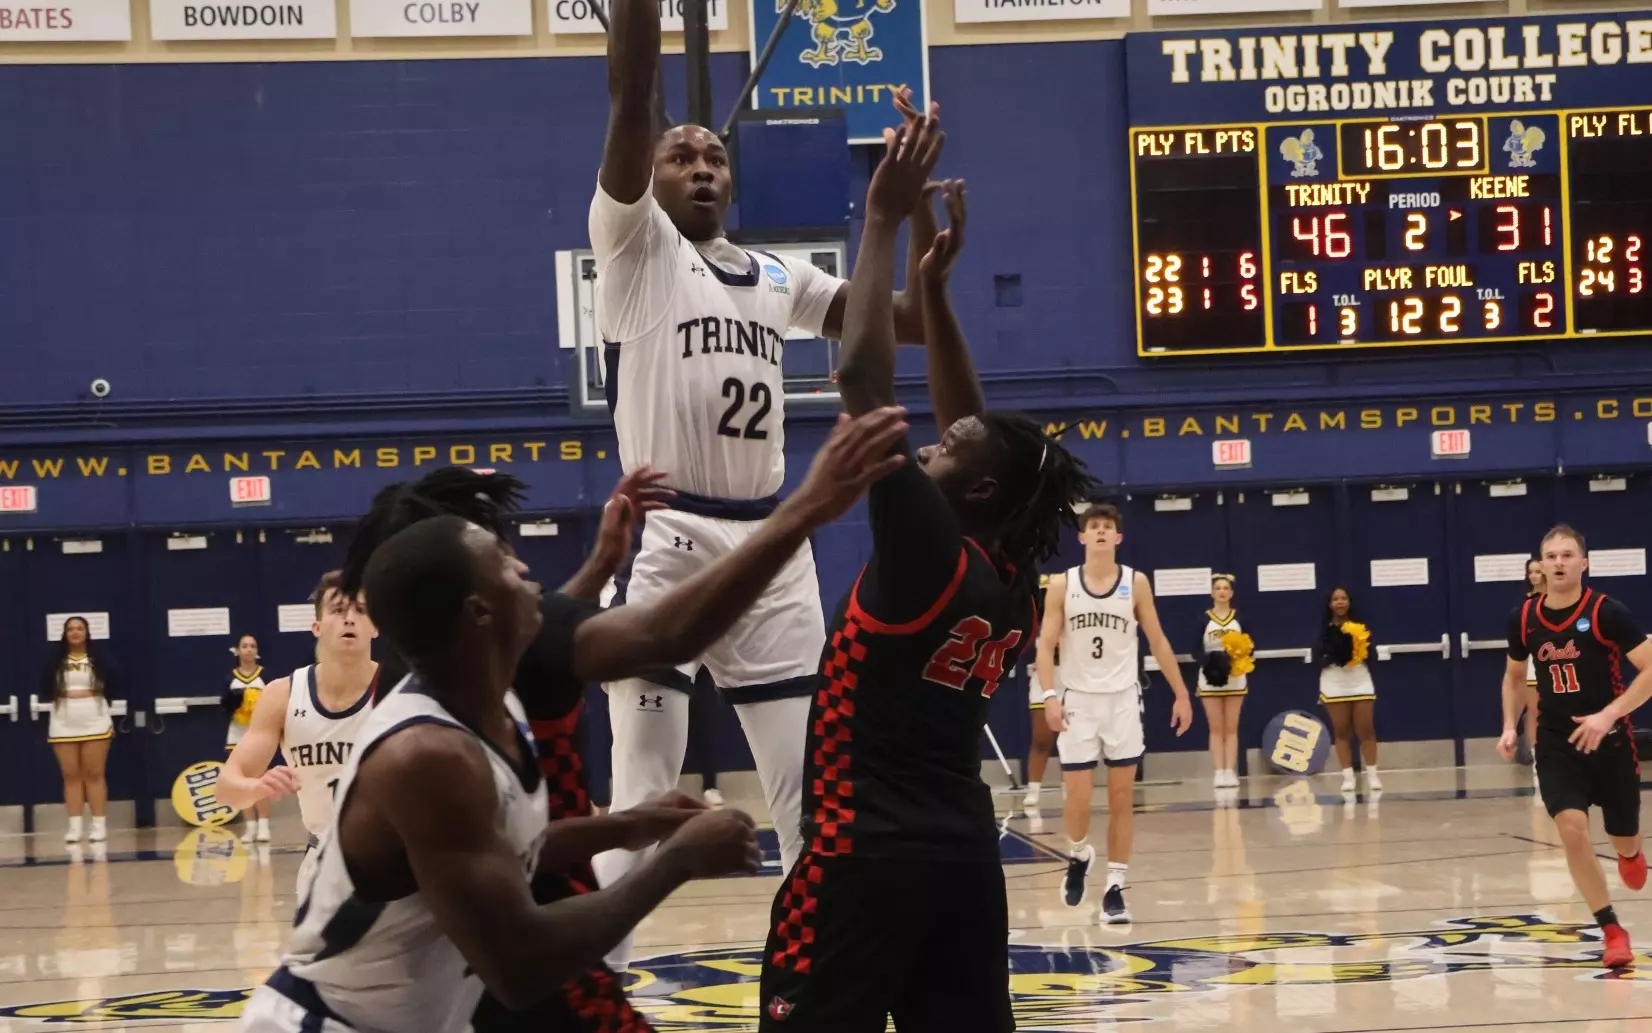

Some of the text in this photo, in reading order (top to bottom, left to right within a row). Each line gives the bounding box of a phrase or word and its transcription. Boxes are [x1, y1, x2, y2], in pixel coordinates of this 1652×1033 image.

[0, 8, 73, 29] BATES
[184, 5, 304, 26] BOWDOIN
[404, 3, 480, 23] COLBY
[1162, 20, 1652, 83] TRINITY COLLEGE
[770, 84, 908, 106] TRINITY
[1264, 74, 1557, 113] OGRODNIK COURT
[1571, 114, 1642, 138] PLY FL
[1138, 131, 1254, 156] PLY FL PTS
[1364, 122, 1479, 170] 16:03
[1285, 183, 1370, 207] TRINITY
[1389, 192, 1441, 208] PERIOD
[1470, 175, 1529, 199] KEENE
[1293, 214, 1350, 258] 46
[1405, 214, 1427, 251] 2
[1587, 235, 1641, 263] 12 2
[1145, 252, 1256, 283] 22 1 6
[1364, 265, 1473, 291] PLYR FOUL
[1518, 262, 1555, 284] FLS
[1280, 272, 1317, 294] FLS
[1476, 288, 1505, 300] T.O.L.
[1579, 268, 1643, 296] 24 3
[1146, 284, 1257, 315] 23 1 5
[1332, 295, 1361, 307] T.O.L.
[1533, 293, 1553, 328] 2
[1308, 305, 1316, 335] 1
[1341, 308, 1356, 335] 3
[1390, 296, 1461, 334] 12 2
[1484, 301, 1500, 329] 3
[678, 316, 785, 366] TRINIT
[717, 377, 772, 440] 22
[1219, 442, 1245, 462] EXIT
[1440, 432, 1465, 453] EXIT
[2, 488, 29, 508] EXIT
[237, 478, 265, 499] EXIT
[1069, 612, 1130, 633] TRINITY
[922, 615, 1022, 699] 24
[1092, 636, 1104, 659] 3
[1549, 663, 1581, 694] 11
[290, 742, 354, 768] TRIN
[185, 766, 233, 822] BLUE
